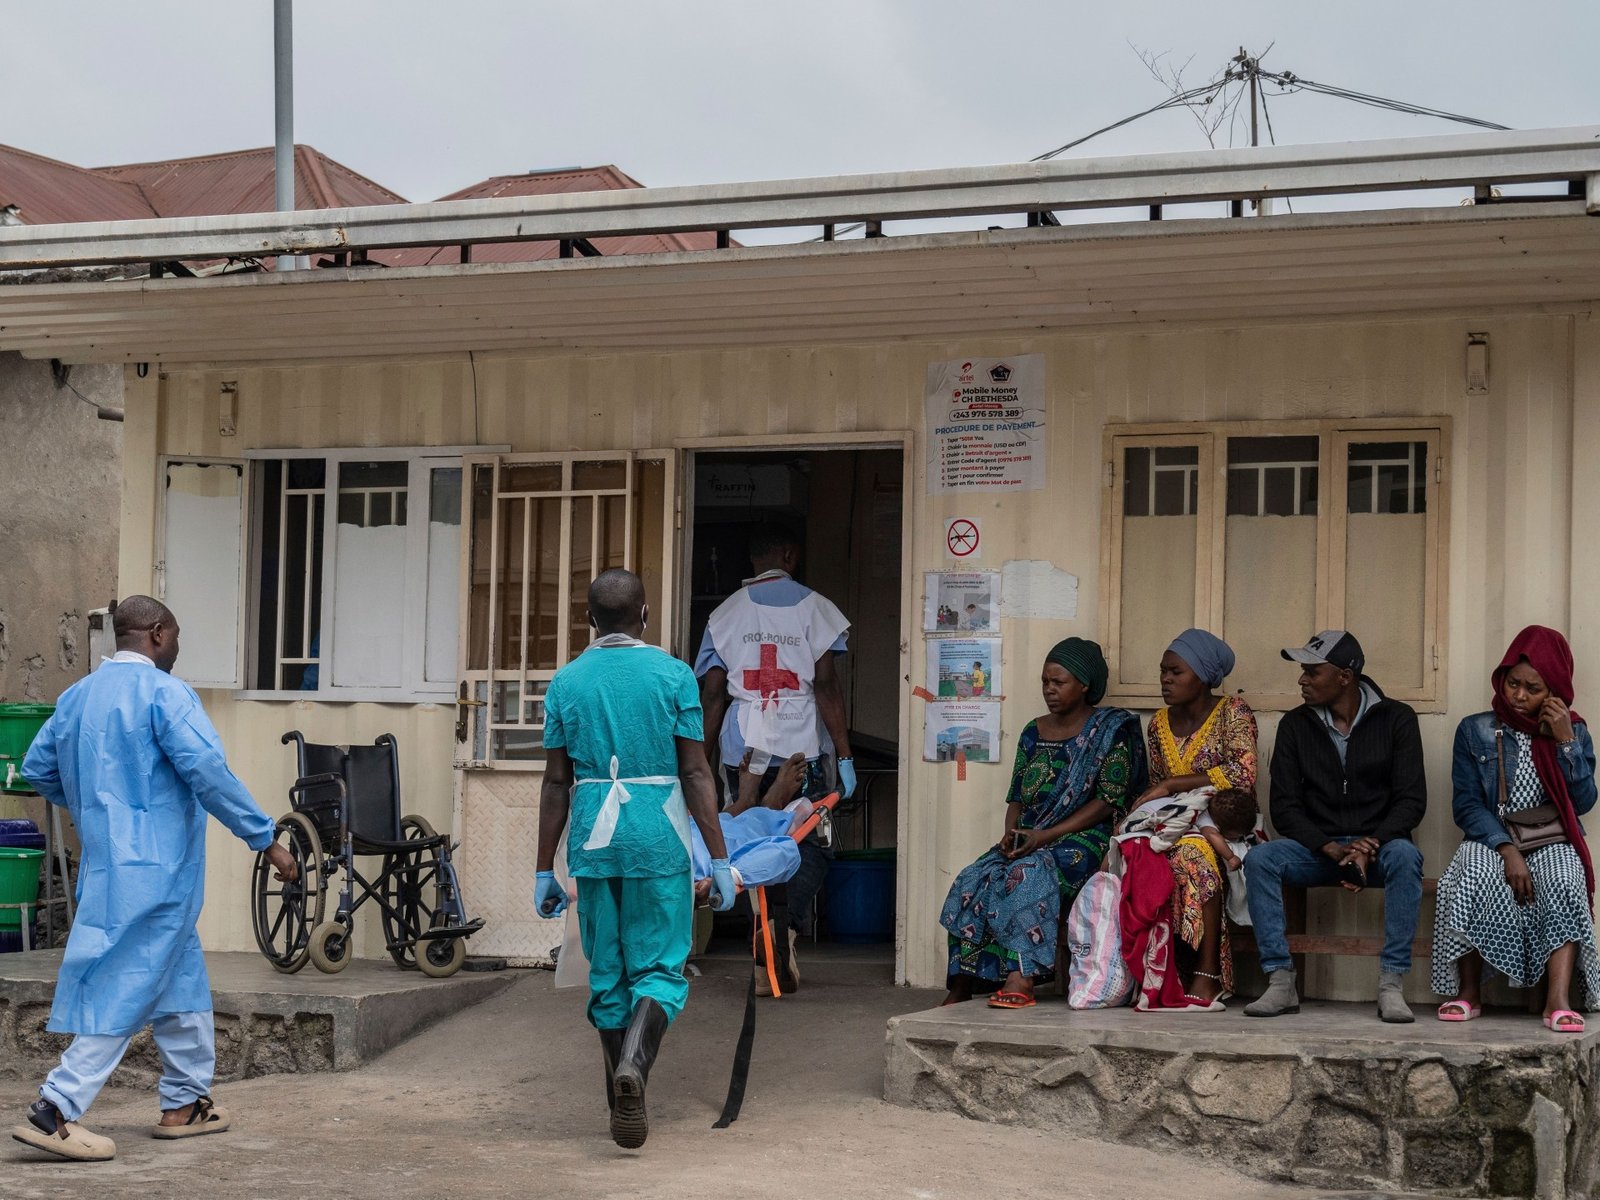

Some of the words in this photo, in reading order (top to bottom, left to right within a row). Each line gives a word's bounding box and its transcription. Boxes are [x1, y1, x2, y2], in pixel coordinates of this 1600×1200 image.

[992, 387, 1018, 395] Money
[936, 425, 980, 434] PROCEDURE
[997, 422, 1036, 431] PAYEMENT
